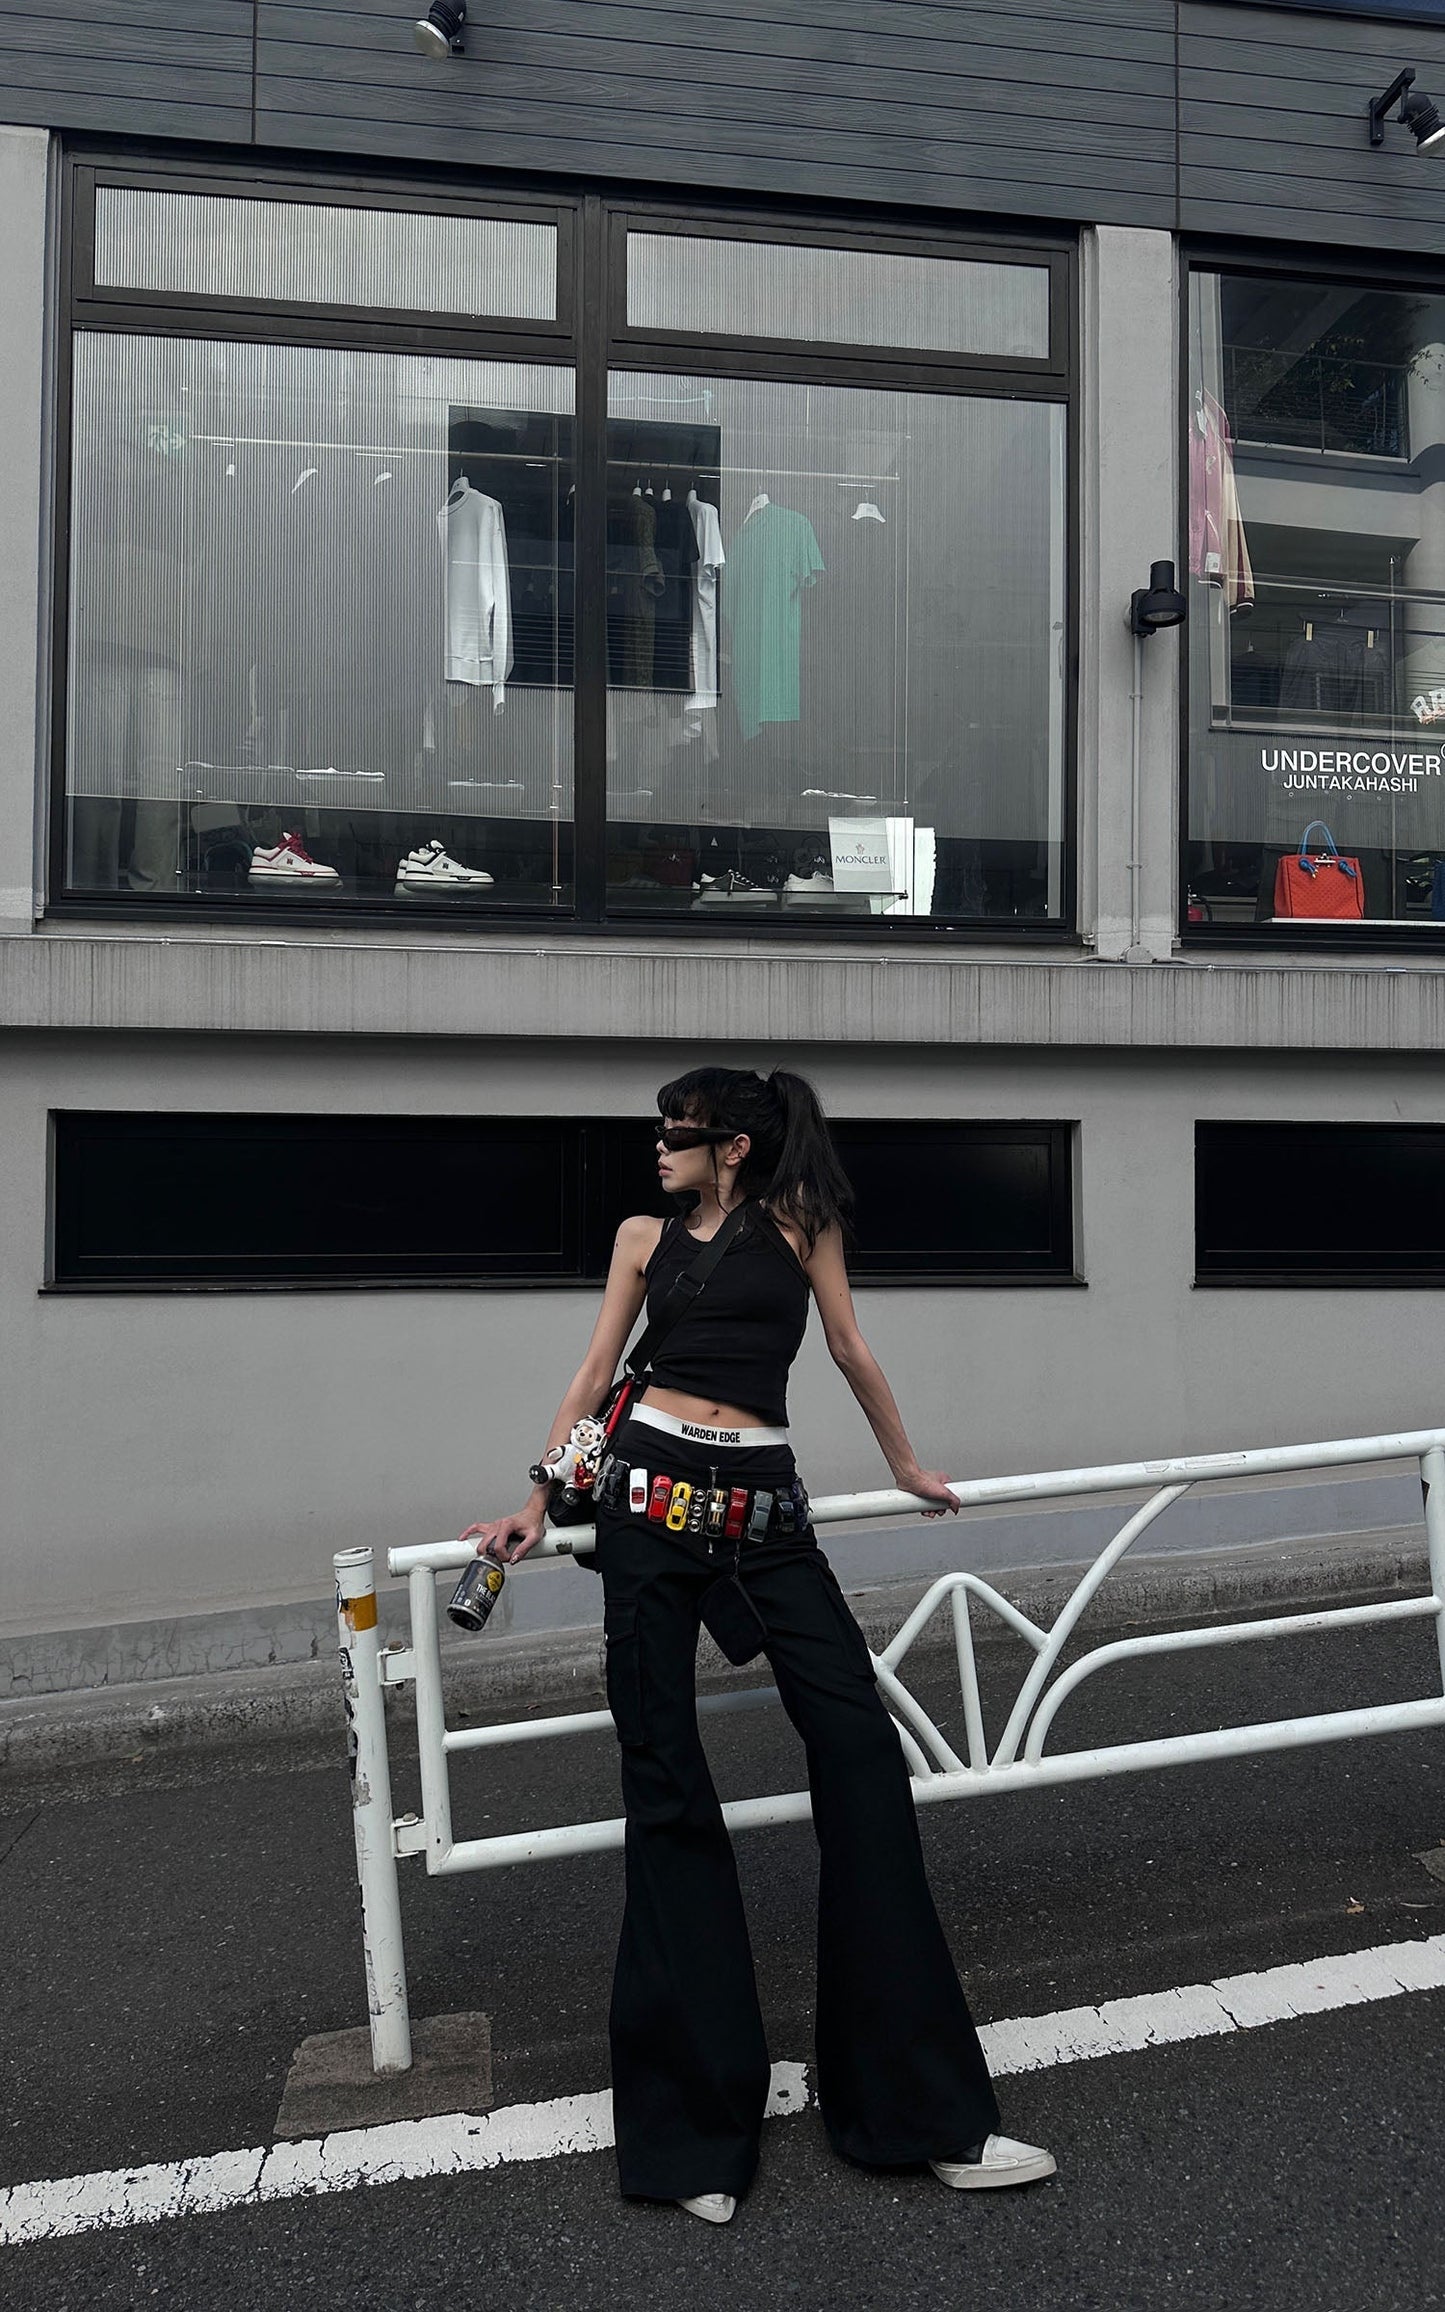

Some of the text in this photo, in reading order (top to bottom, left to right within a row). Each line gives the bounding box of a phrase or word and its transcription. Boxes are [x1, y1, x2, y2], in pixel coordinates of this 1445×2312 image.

[1261, 749, 1441, 776] UNDERCOVER
[1283, 774, 1418, 793] JUNTAKAHASHI
[835, 855, 887, 865] MONCLER
[681, 1423, 741, 1443] WARDEN EDGE
